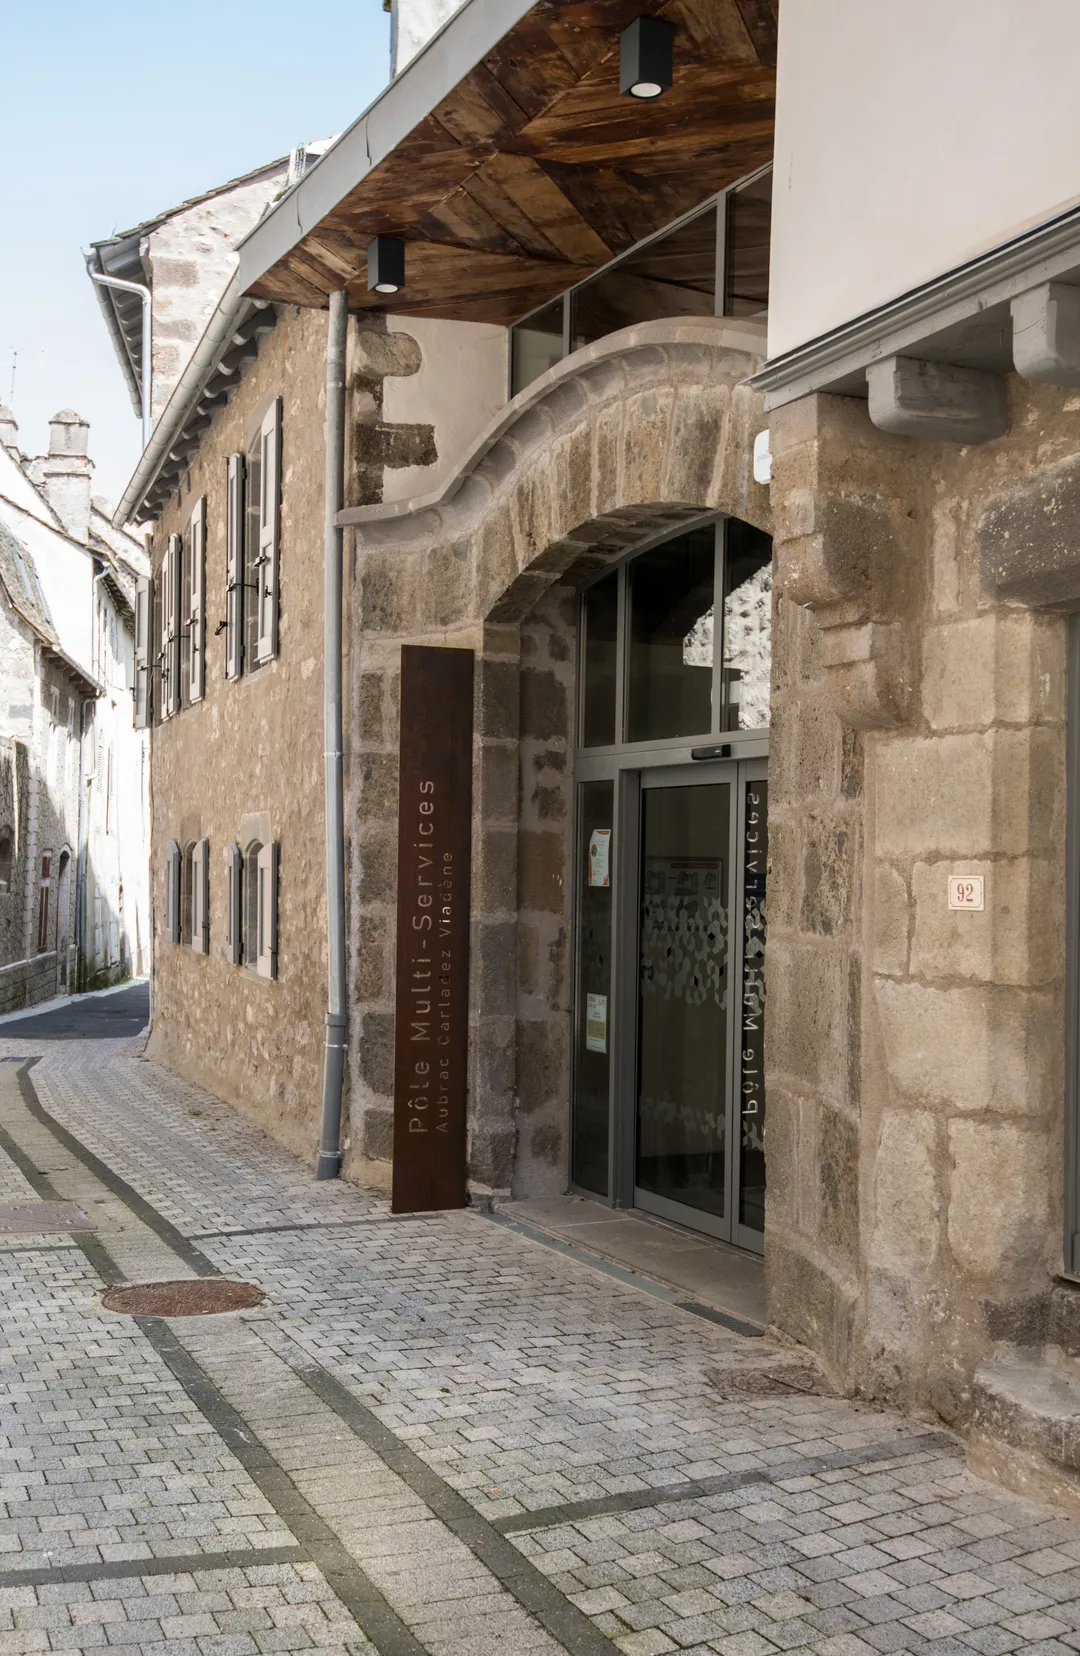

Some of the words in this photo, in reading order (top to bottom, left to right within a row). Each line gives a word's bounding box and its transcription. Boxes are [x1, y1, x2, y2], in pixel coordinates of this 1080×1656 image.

[410, 780, 434, 1041] Multi-Services
[438, 852, 453, 938] Viadène
[957, 883, 974, 902] 92
[437, 950, 451, 1045] Carladez
[407, 1061, 430, 1133] Pôle
[435, 1058, 449, 1133] Aubrac
